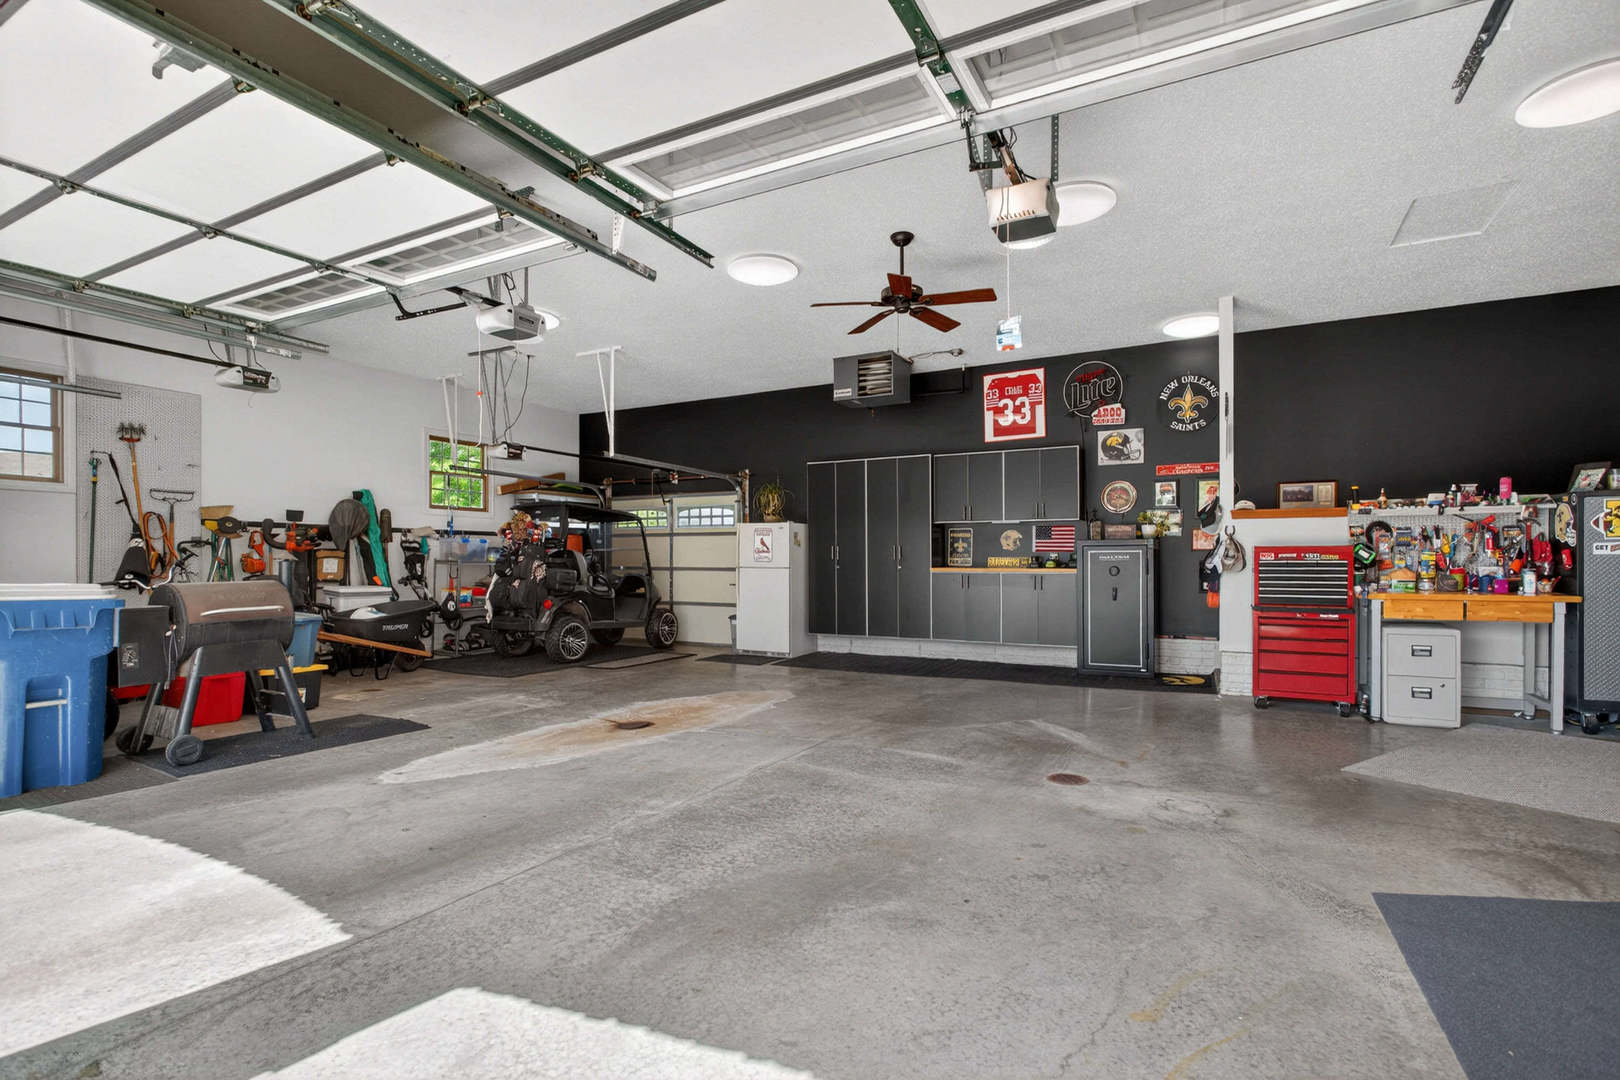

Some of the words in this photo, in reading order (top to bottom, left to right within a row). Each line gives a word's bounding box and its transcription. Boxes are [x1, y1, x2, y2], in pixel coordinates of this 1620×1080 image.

[986, 388, 999, 400] 33
[1028, 383, 1042, 394] 33
[1160, 379, 1179, 400] NEW
[1181, 375, 1219, 398] ORLEANS
[998, 396, 1031, 427] 33
[1170, 418, 1207, 431] SAINTS
